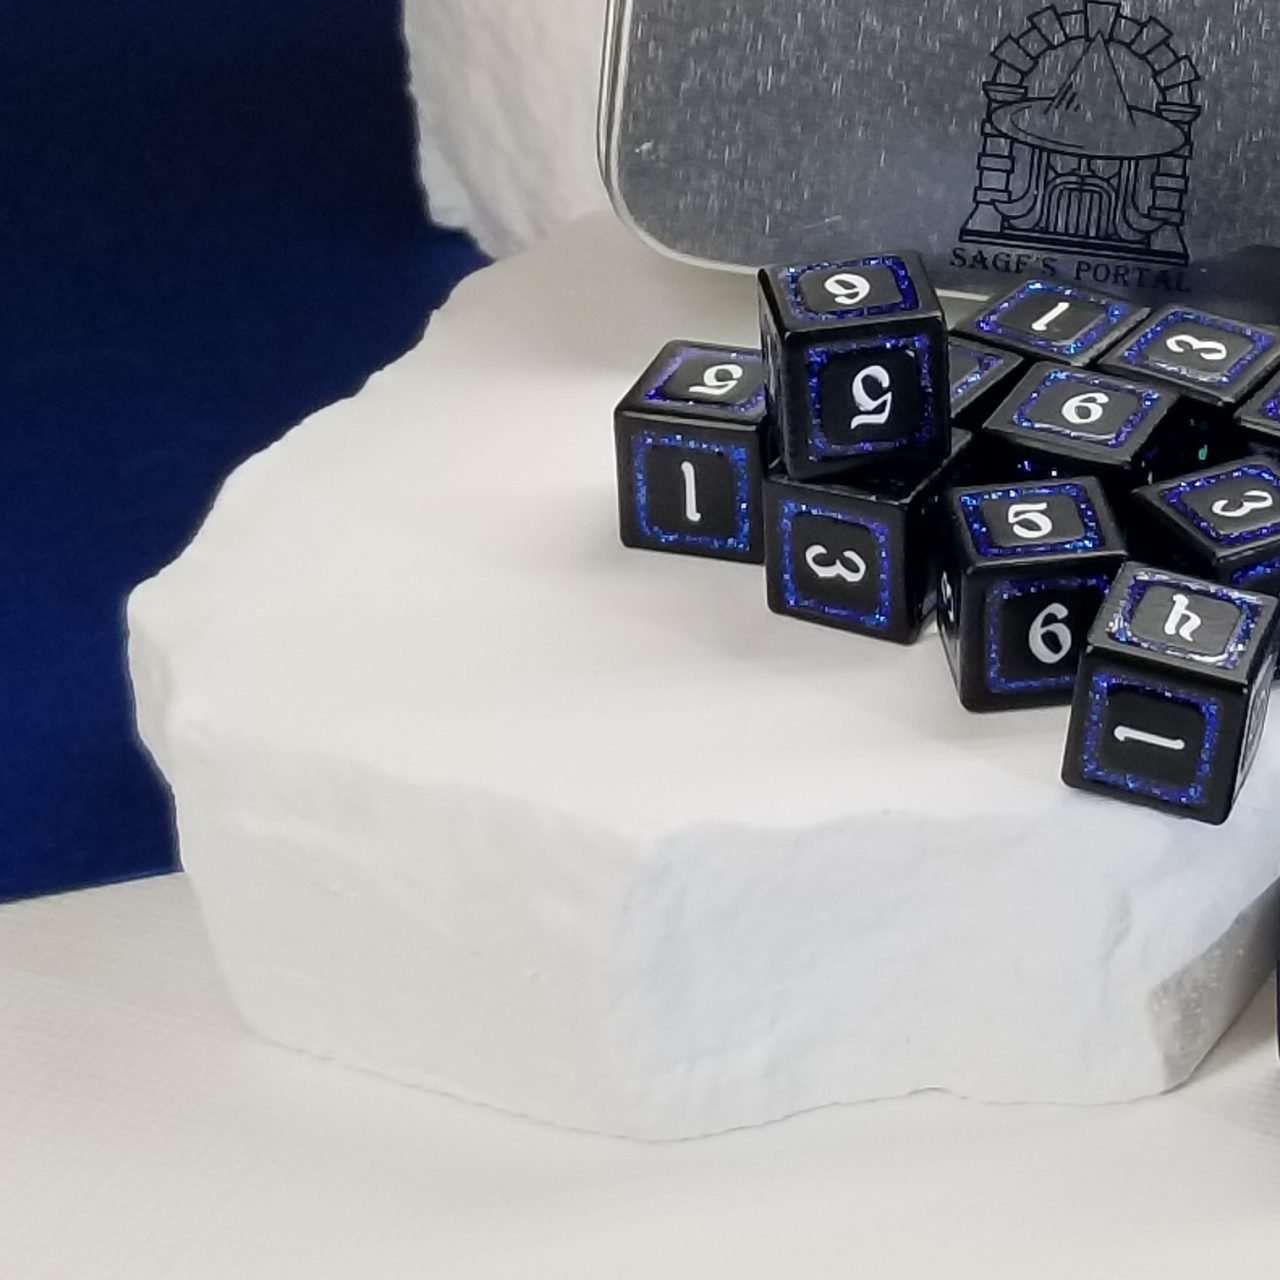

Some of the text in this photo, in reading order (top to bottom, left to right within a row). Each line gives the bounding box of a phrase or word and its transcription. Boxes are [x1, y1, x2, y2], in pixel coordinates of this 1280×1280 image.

[1074, 260, 1192, 293] PORTAL
[1031, 301, 1070, 331] 1
[1165, 334, 1227, 361] 3
[688, 364, 743, 396] 5
[850, 365, 892, 430] 5
[1061, 392, 1109, 425] 6
[681, 461, 701, 522] 1
[1211, 490, 1273, 517] 3
[1007, 502, 1053, 539] 5
[805, 544, 866, 582] 3
[1028, 602, 1072, 664] 6
[1113, 725, 1185, 750] 1
